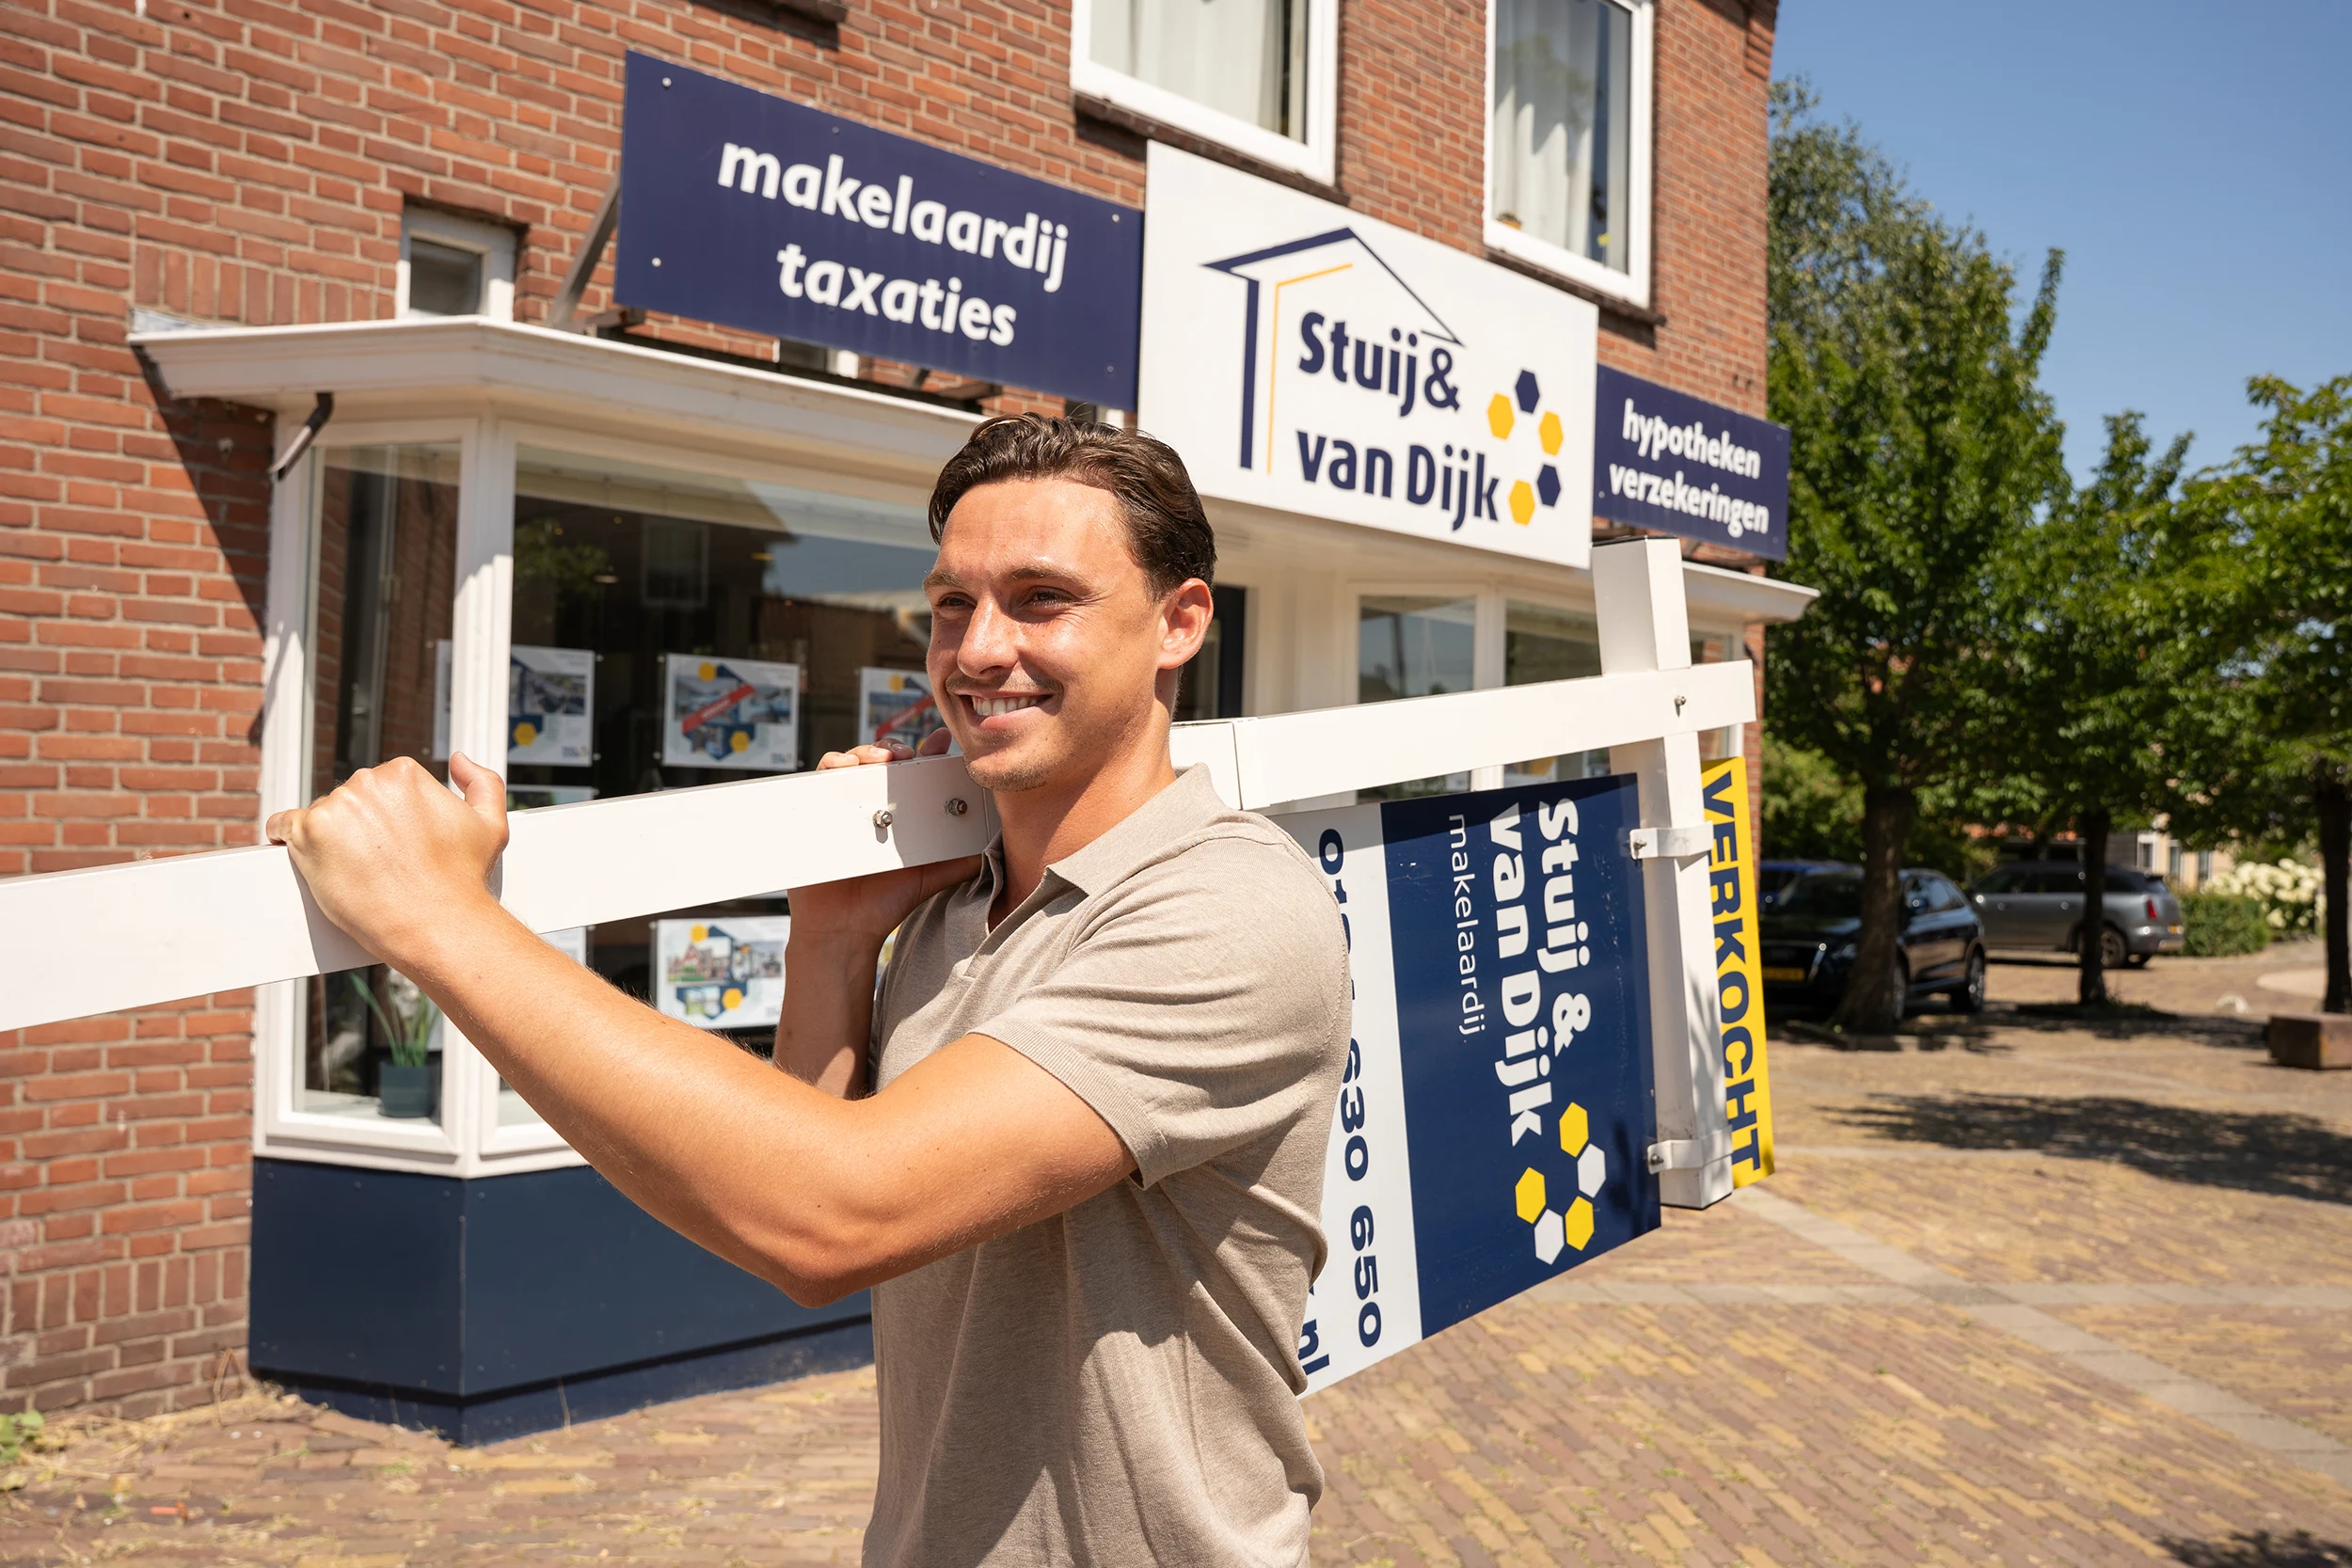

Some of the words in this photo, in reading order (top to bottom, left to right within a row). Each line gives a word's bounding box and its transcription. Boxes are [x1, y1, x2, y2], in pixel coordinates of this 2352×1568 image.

[717, 142, 1069, 293] makelaardij
[776, 243, 1017, 346] taxaties
[1296, 430, 1393, 499] van
[1406, 443, 1500, 531] Dijk
[1609, 463, 1770, 538] verzekeringen
[1622, 398, 1761, 480] hypotheken
[1448, 814, 1486, 1036] makelaardij
[1489, 801, 1530, 959] van
[1536, 798, 1591, 974] Stuij
[1551, 991, 1592, 1057] &
[1702, 769, 1760, 1171] VERKOCHT
[1340, 1037, 1369, 1182] 630
[1494, 969, 1553, 1148] Dijk
[1350, 1204, 1382, 1348] 650
